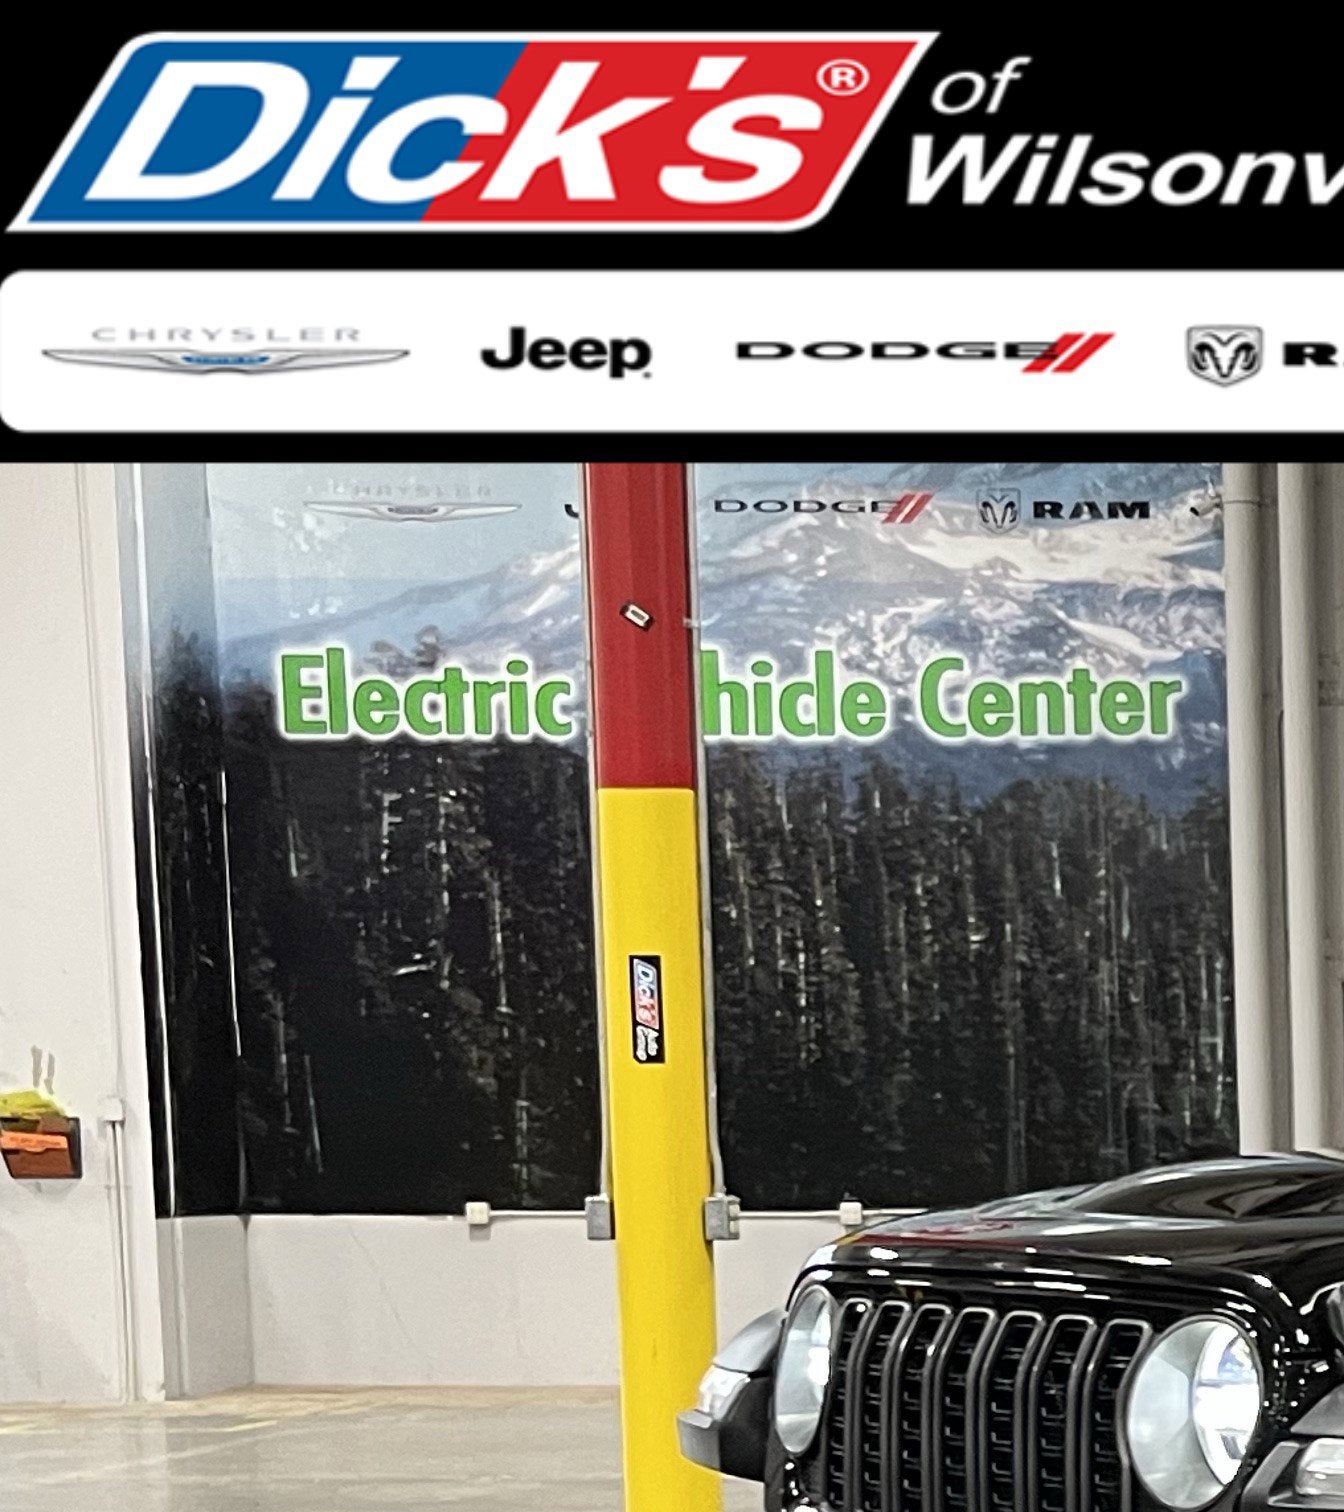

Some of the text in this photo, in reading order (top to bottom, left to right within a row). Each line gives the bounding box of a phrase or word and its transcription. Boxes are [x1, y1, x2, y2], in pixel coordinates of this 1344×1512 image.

[1031, 499, 1151, 520] RAM
[282, 648, 1182, 738] Electric hicle Center
